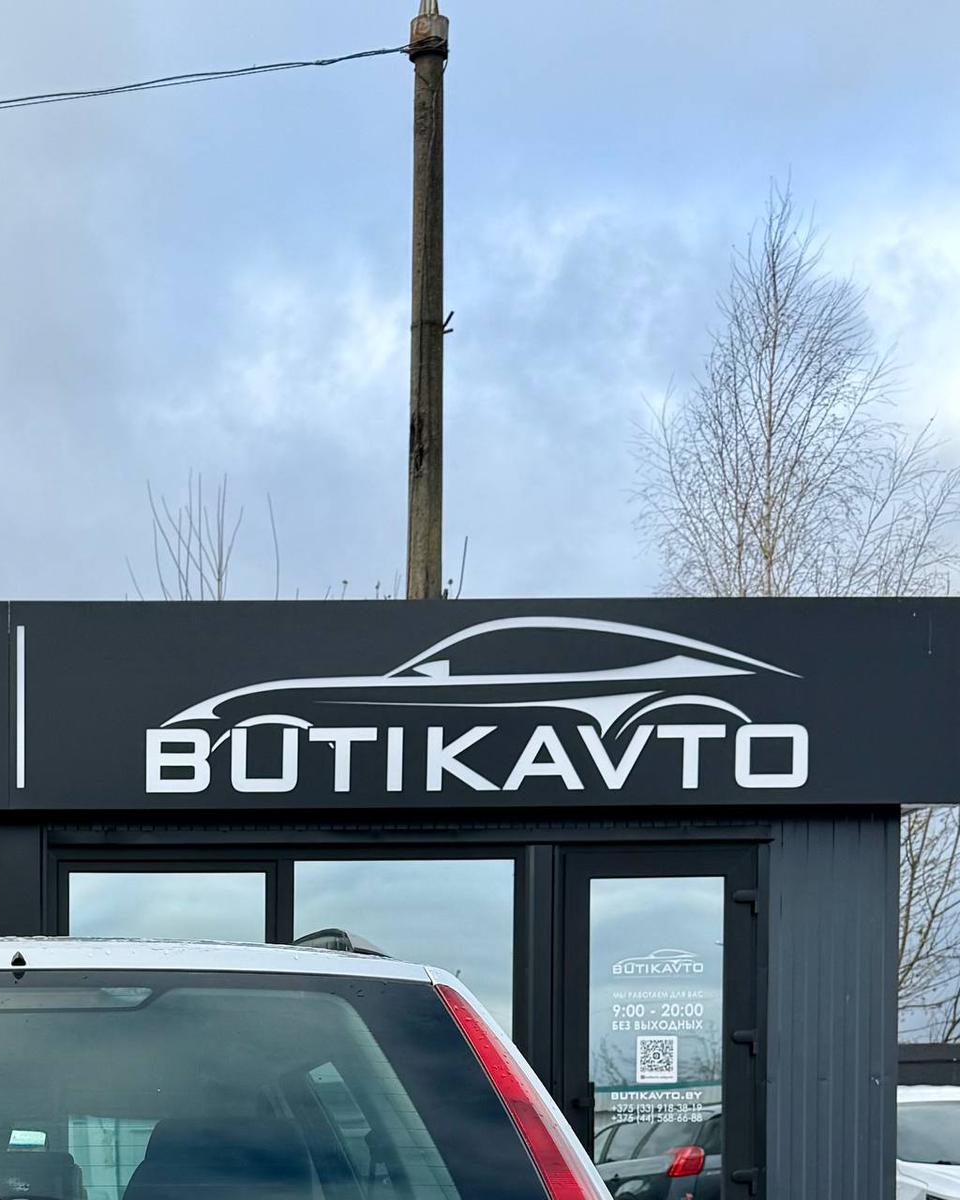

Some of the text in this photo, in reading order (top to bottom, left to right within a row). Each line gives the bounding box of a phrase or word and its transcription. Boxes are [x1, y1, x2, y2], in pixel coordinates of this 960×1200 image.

[145, 722, 809, 792] BUTIKAVTO
[612, 962, 704, 974] BUTIKAVTO
[612, 1004, 645, 1017] 9:00
[661, 1003, 704, 1017] 20:00
[612, 1019, 704, 1031] БЕЗ ВЫХОДНЫХ
[610, 1091, 703, 1100] BUTIKAVTO.BY
[612, 1103, 634, 1113] +375
[636, 1103, 654, 1115] (33)
[611, 1113, 634, 1123] +375
[636, 1113, 654, 1125] (44)
